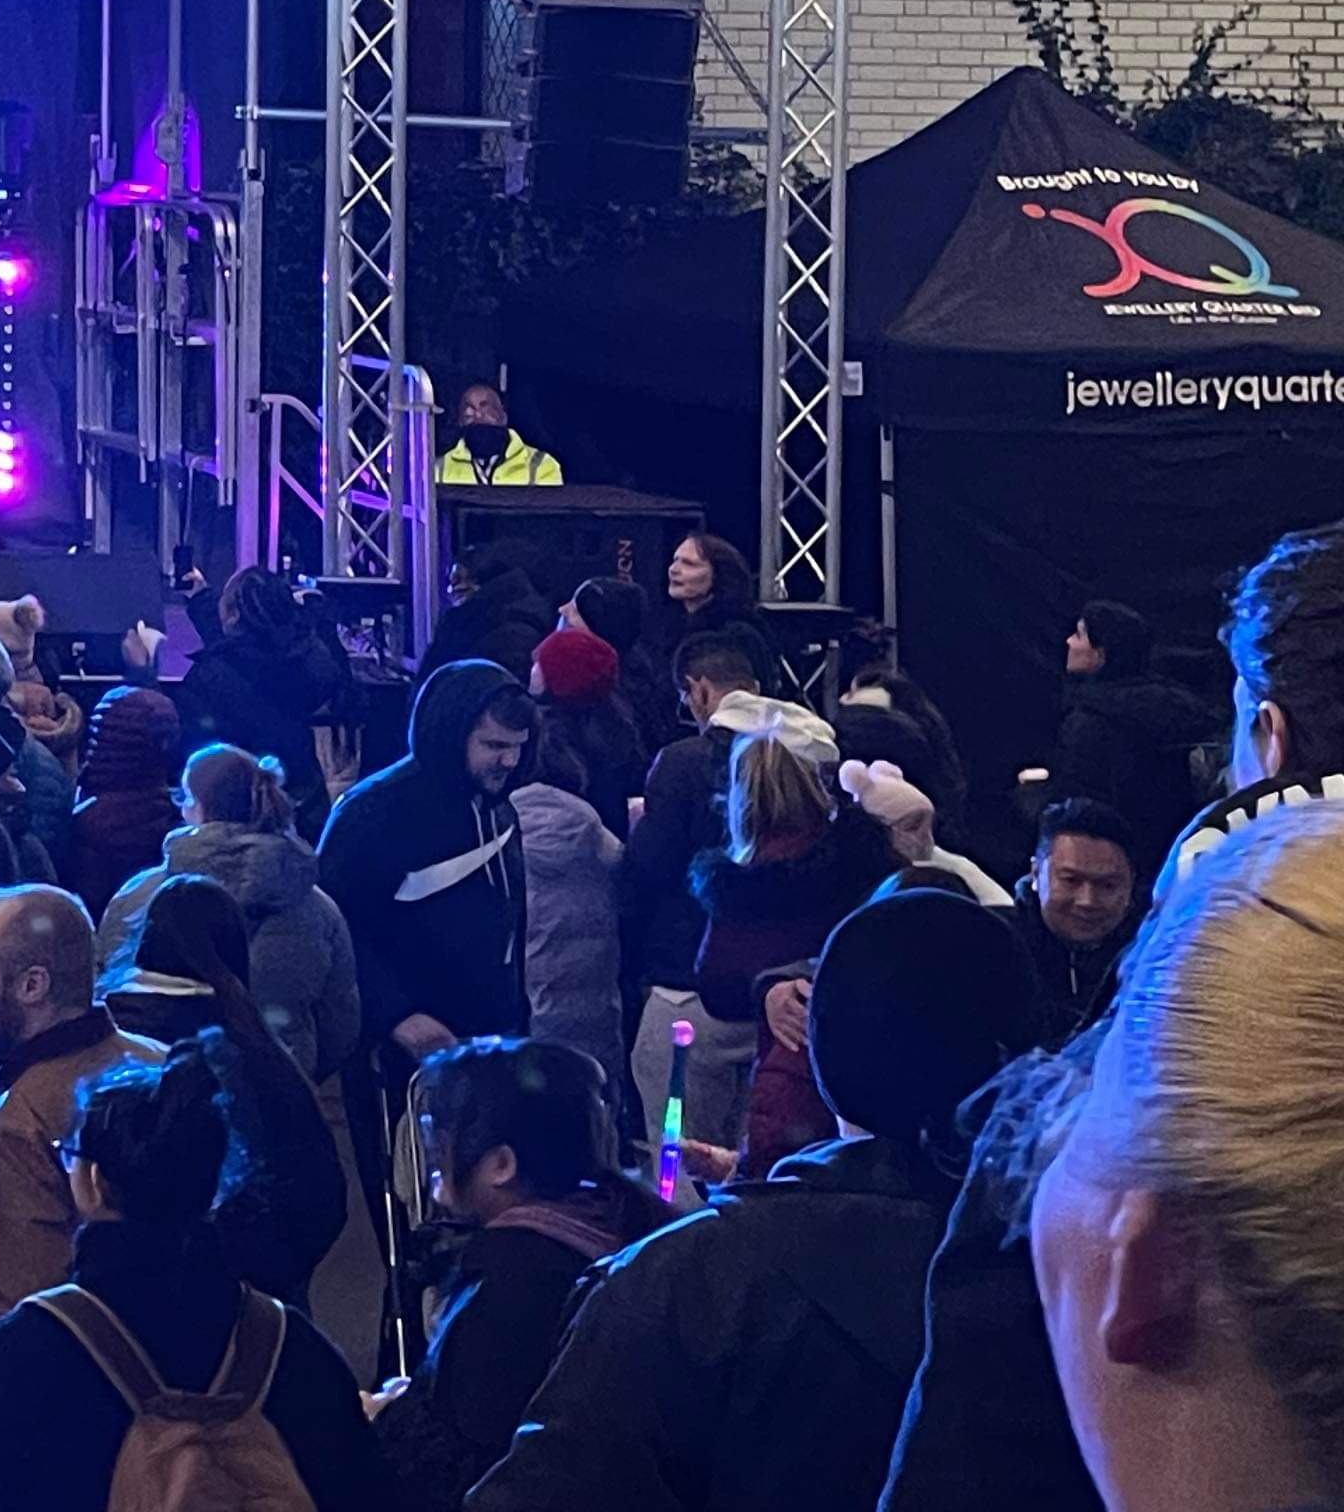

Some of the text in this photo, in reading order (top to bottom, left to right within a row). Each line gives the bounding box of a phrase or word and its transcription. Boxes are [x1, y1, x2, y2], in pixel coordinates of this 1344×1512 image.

[996, 166, 1200, 193] Brought to you by
[1103, 301, 1197, 316] JEWELLERY
[1202, 300, 1289, 316] QUARTER
